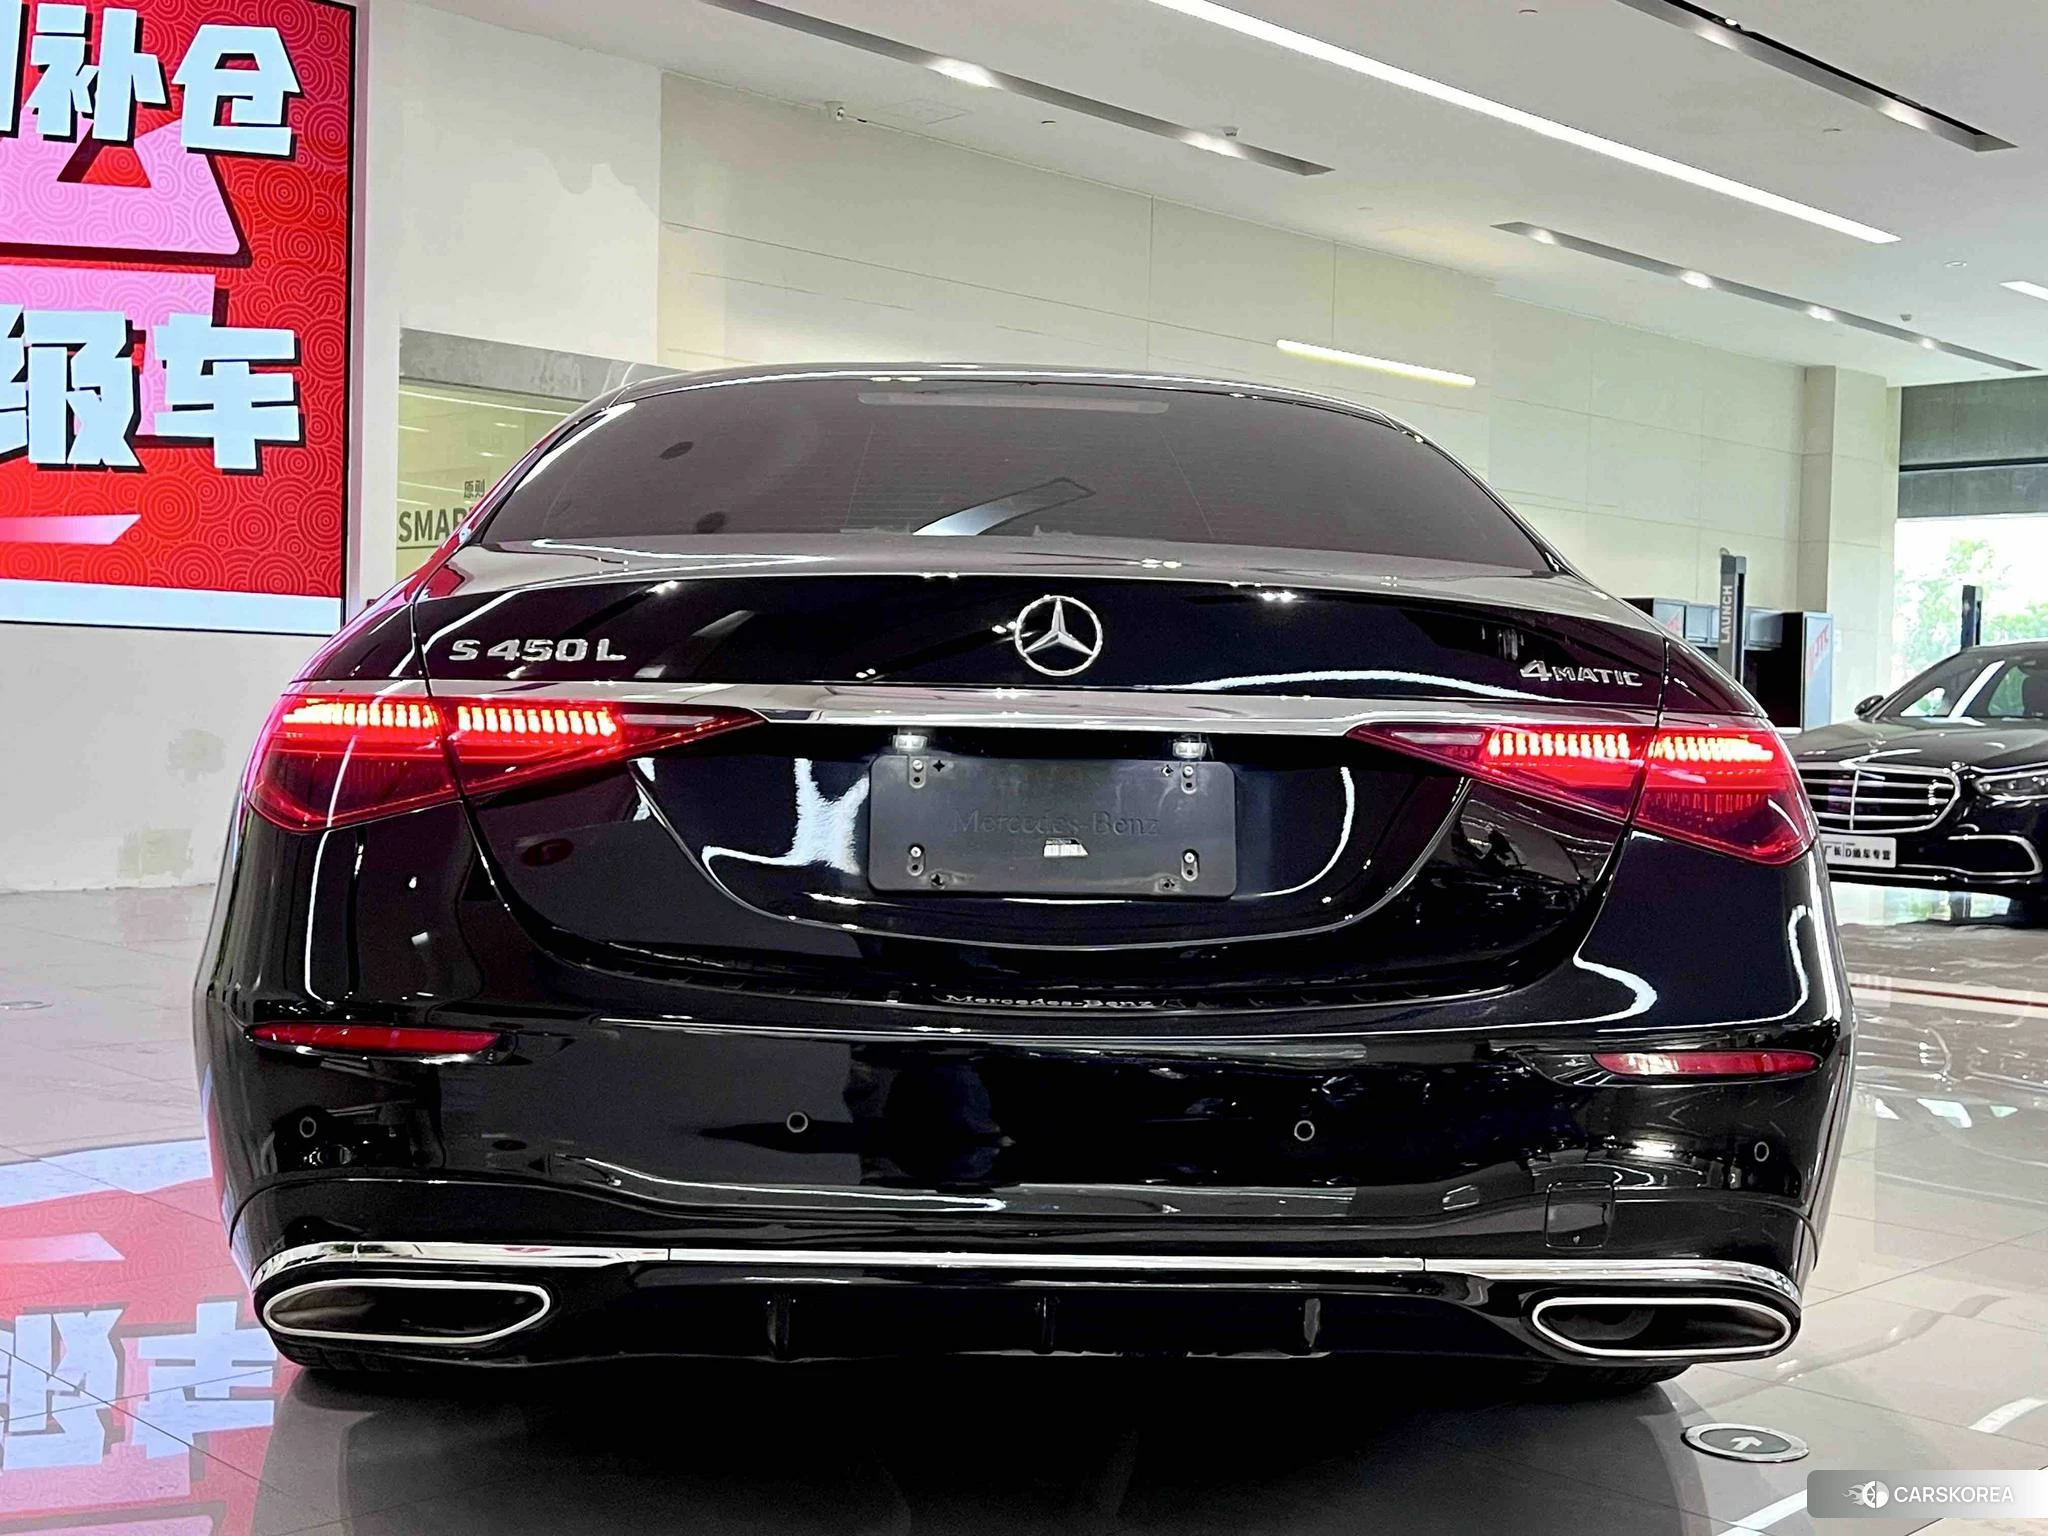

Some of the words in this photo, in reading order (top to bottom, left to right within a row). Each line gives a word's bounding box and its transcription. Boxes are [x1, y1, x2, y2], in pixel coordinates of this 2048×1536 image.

[0, 0, 301, 156] 补仓
[1720, 585, 1733, 644] LAUNCH
[1520, 660, 1643, 687] 4MATIC
[952, 808, 1160, 837] Mercedes-Benz
[946, 994, 1154, 1008] Mercedes-Benz
